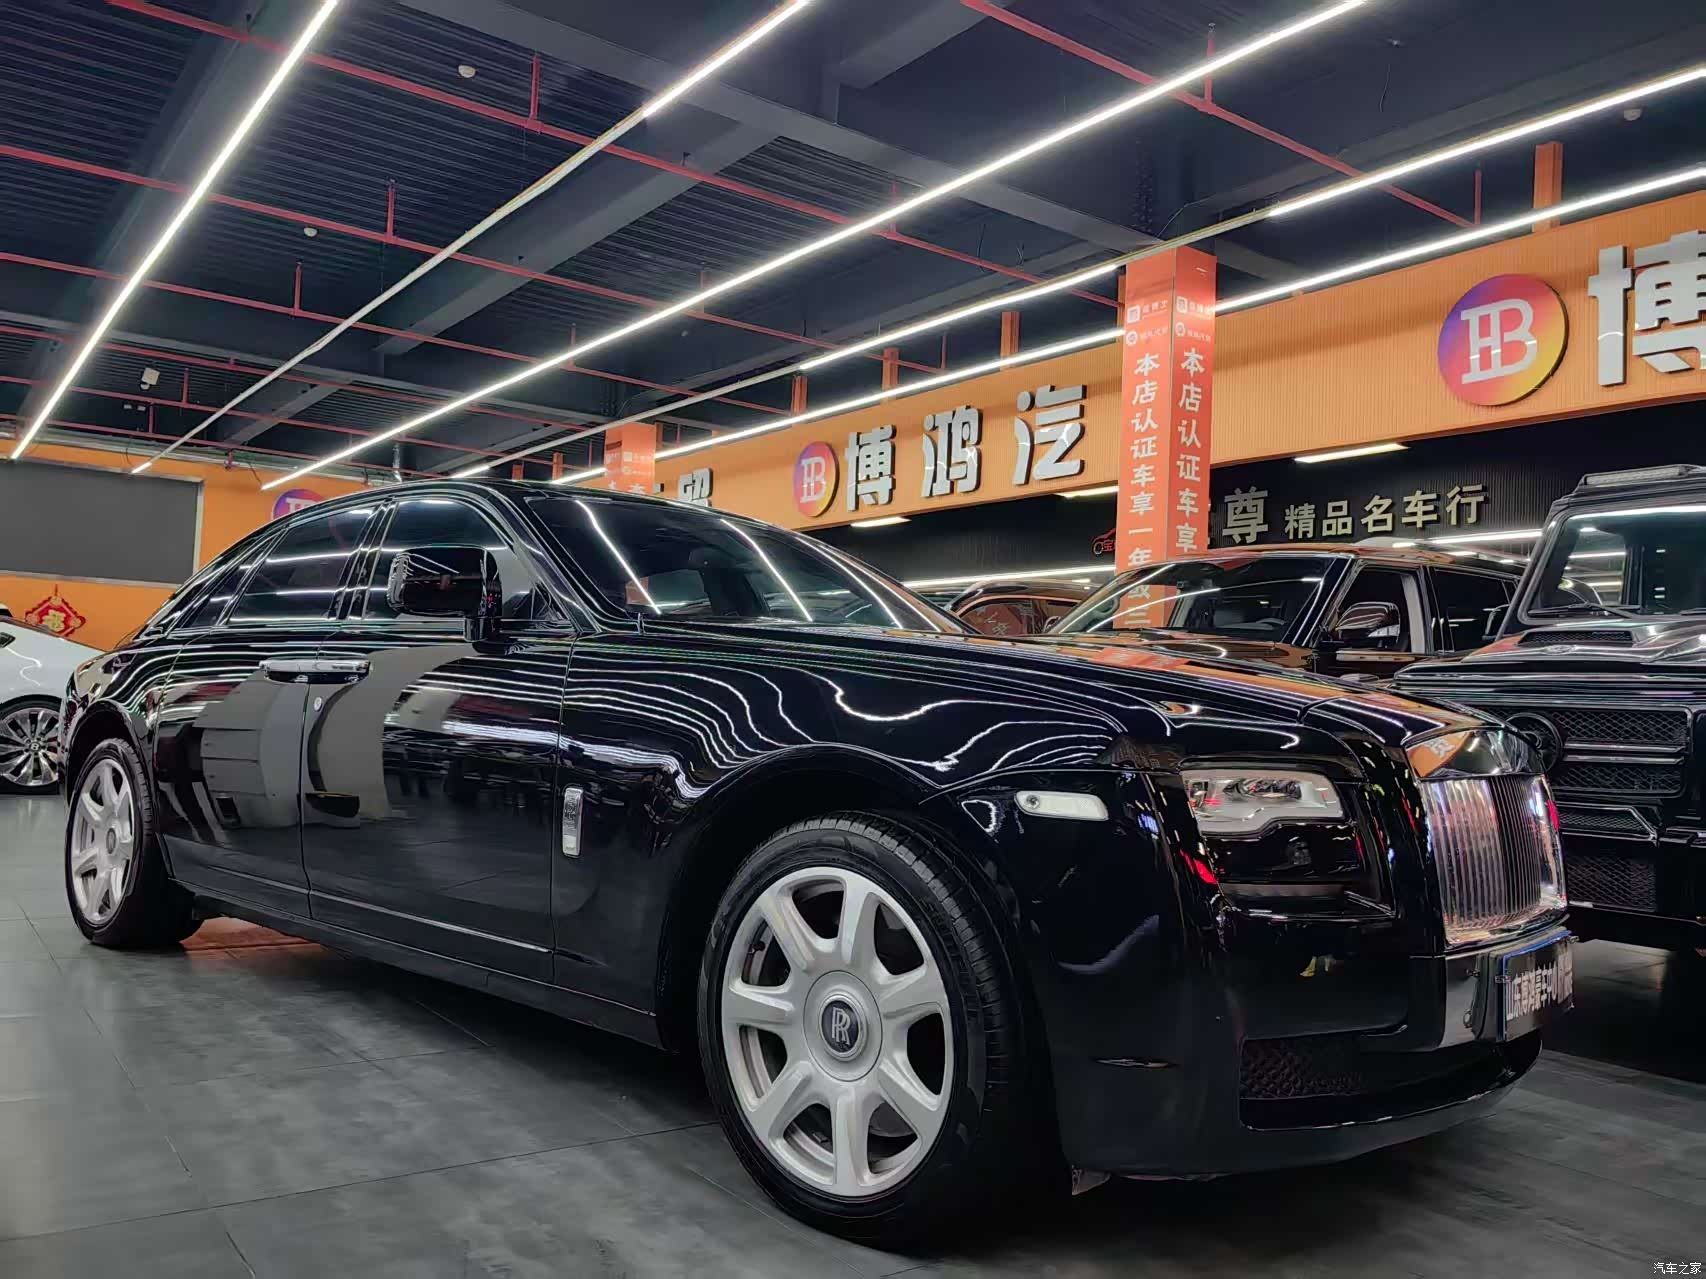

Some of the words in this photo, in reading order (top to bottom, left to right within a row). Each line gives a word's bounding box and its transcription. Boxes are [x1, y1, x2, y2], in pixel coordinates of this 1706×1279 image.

[1175, 347, 1206, 552] 本店认证车享
[1207, 486, 1268, 544] 尊
[1284, 484, 1485, 540] 精品名车行
